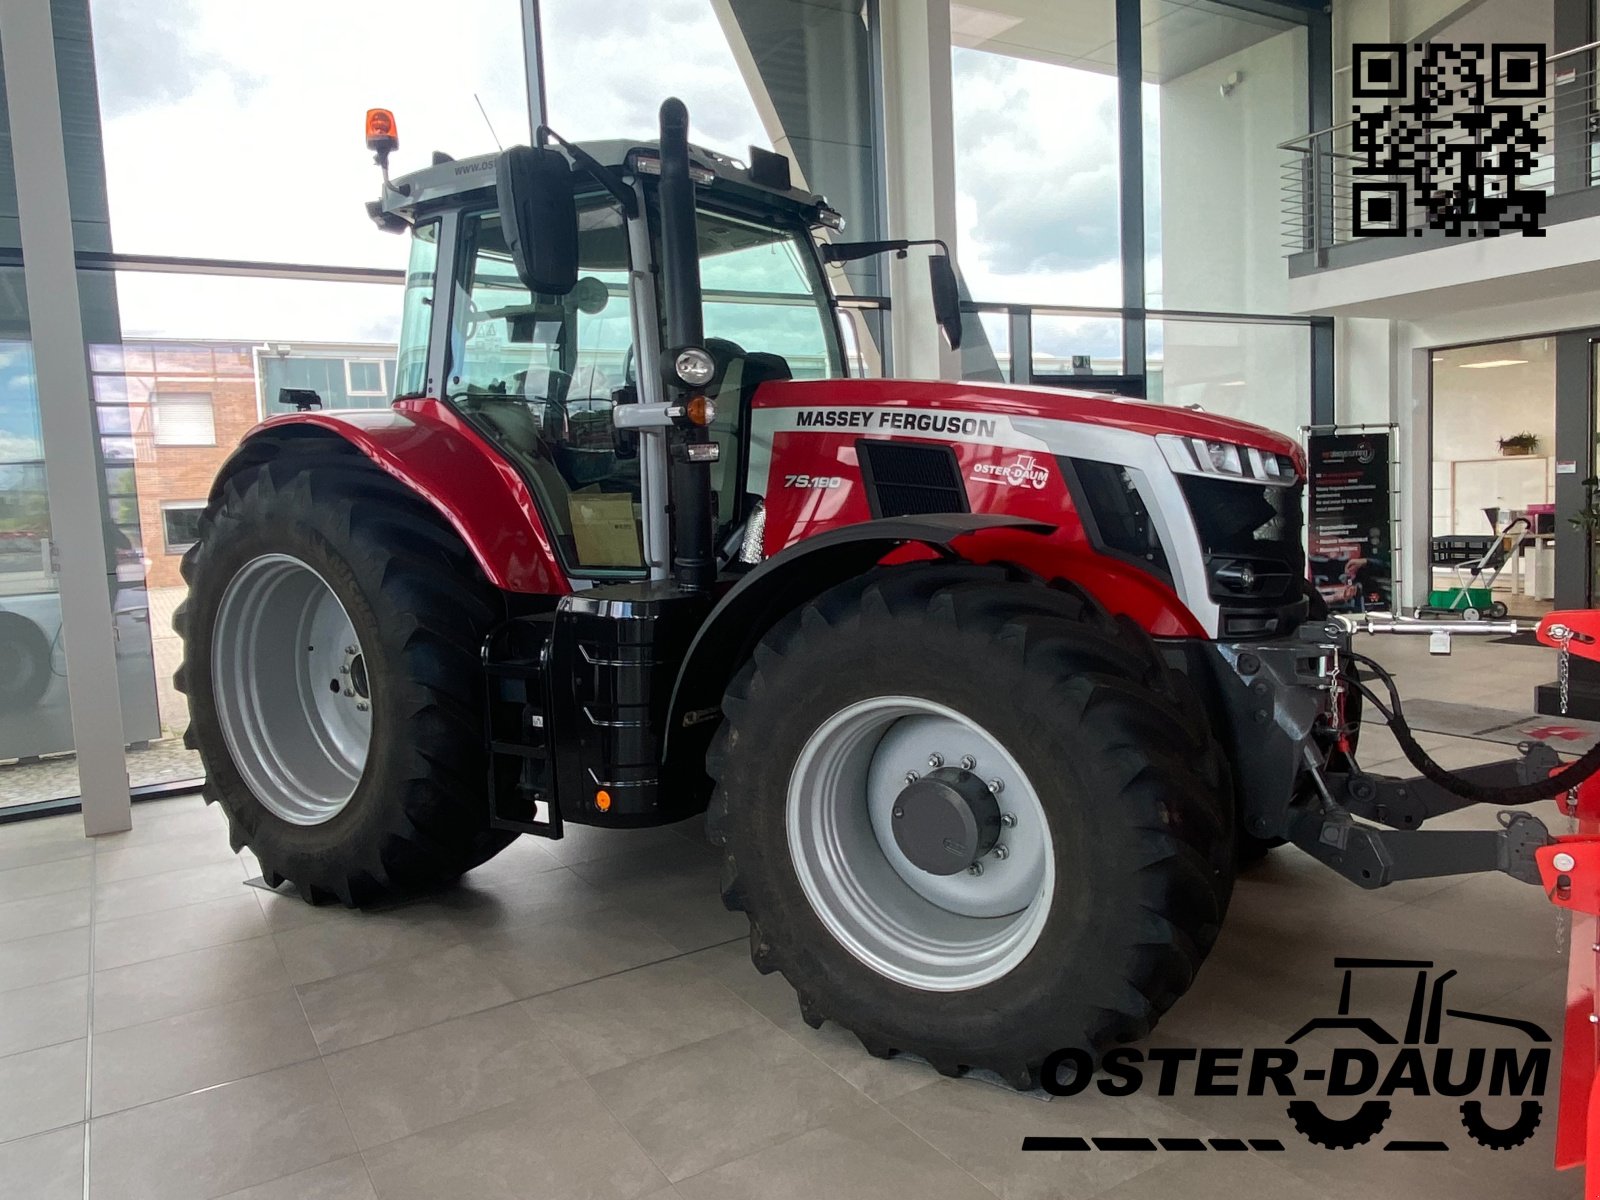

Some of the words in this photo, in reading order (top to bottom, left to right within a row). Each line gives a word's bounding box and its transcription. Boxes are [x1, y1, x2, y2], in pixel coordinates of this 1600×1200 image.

[454, 159, 497, 176] www.os
[796, 411, 874, 427] MASSEY
[878, 412, 996, 438] FERGUSON
[973, 463, 1049, 482] OSTER-DAUM
